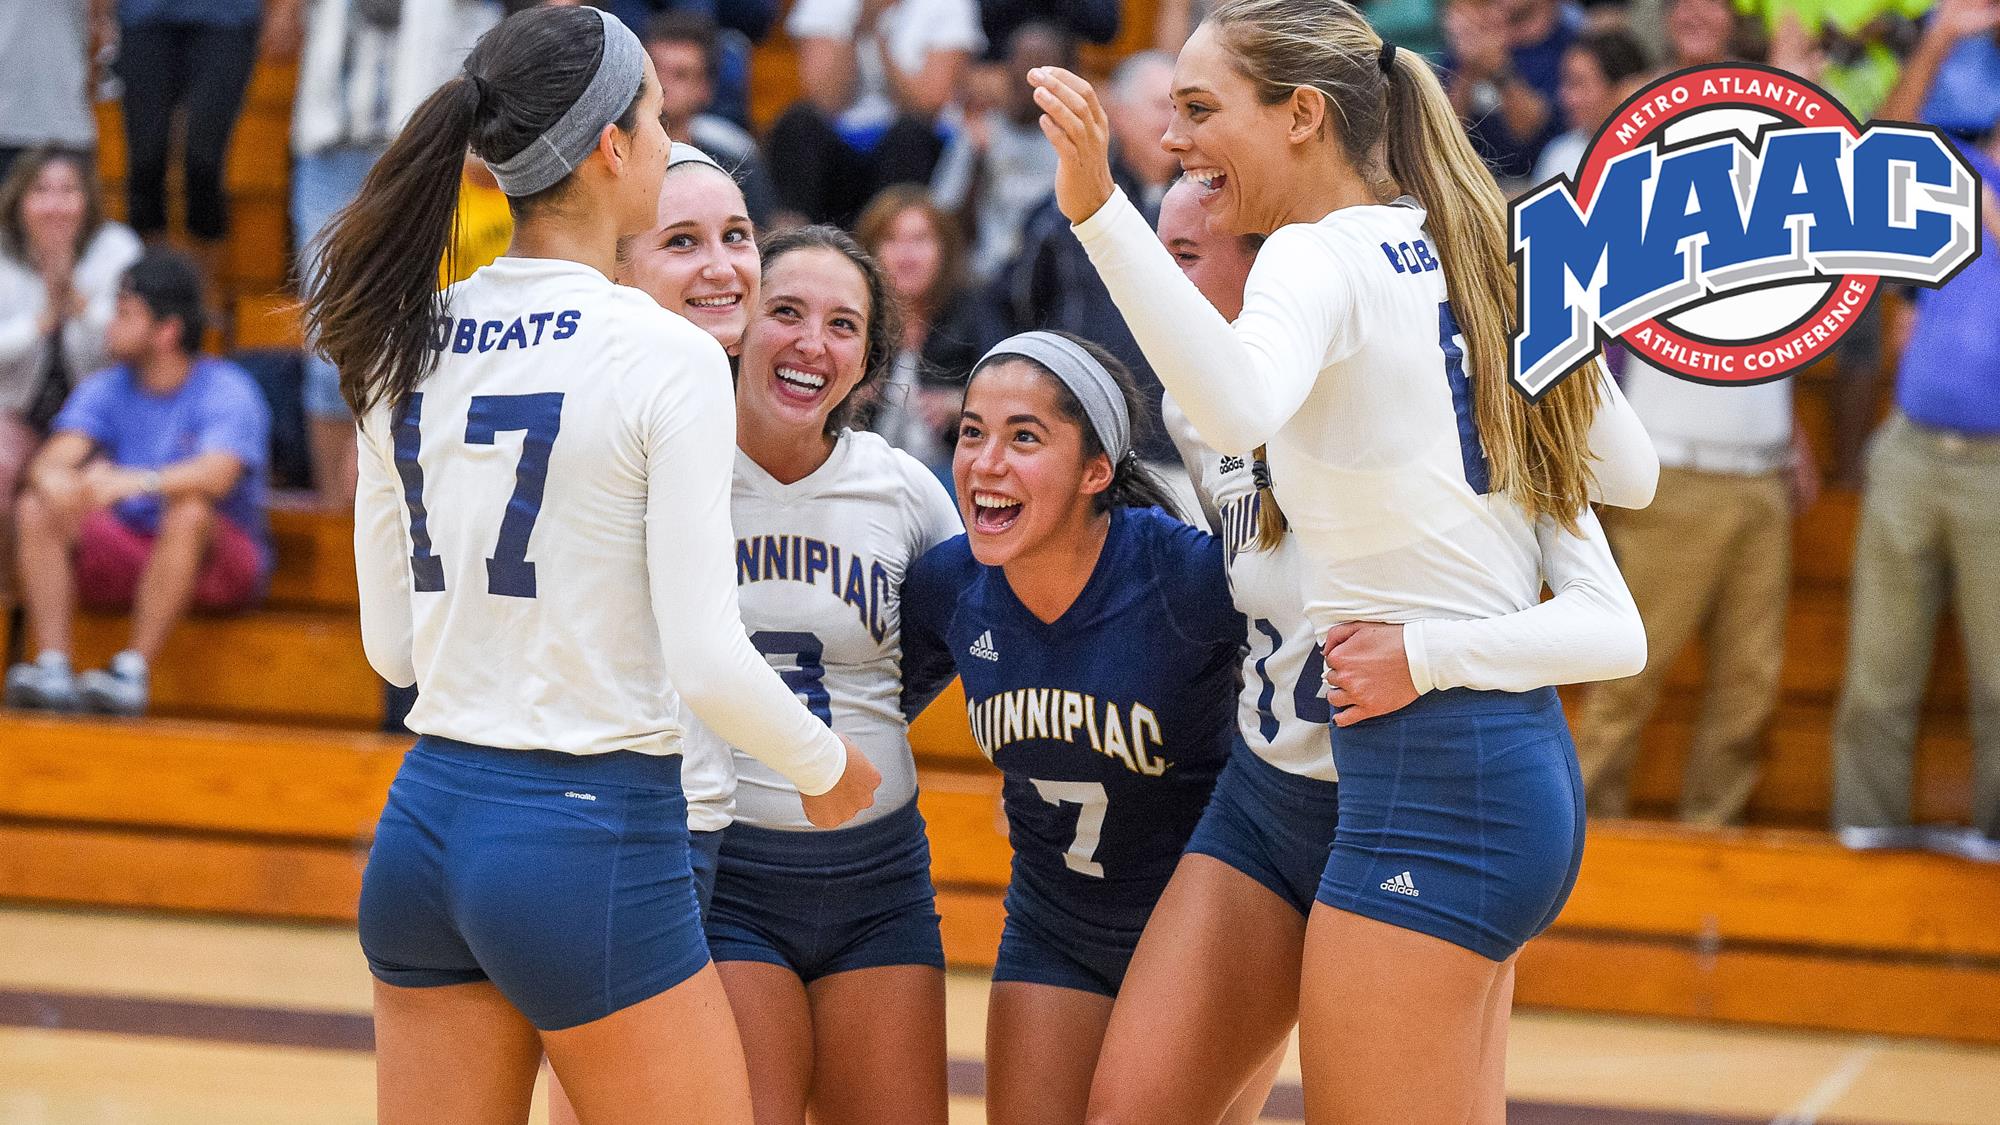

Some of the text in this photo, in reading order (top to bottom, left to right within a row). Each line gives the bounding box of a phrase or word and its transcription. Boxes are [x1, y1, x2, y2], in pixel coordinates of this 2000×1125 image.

[1380, 239, 1439, 274] BOB
[428, 310, 582, 354] OBCATS
[1219, 458, 1245, 475] adidas
[390, 392, 565, 599] 17
[736, 534, 889, 646] NNIPIAC
[969, 645, 999, 662] adidas
[564, 791, 597, 801] climalite
[1029, 778, 1109, 879] 7
[1379, 882, 1420, 897] adidas
